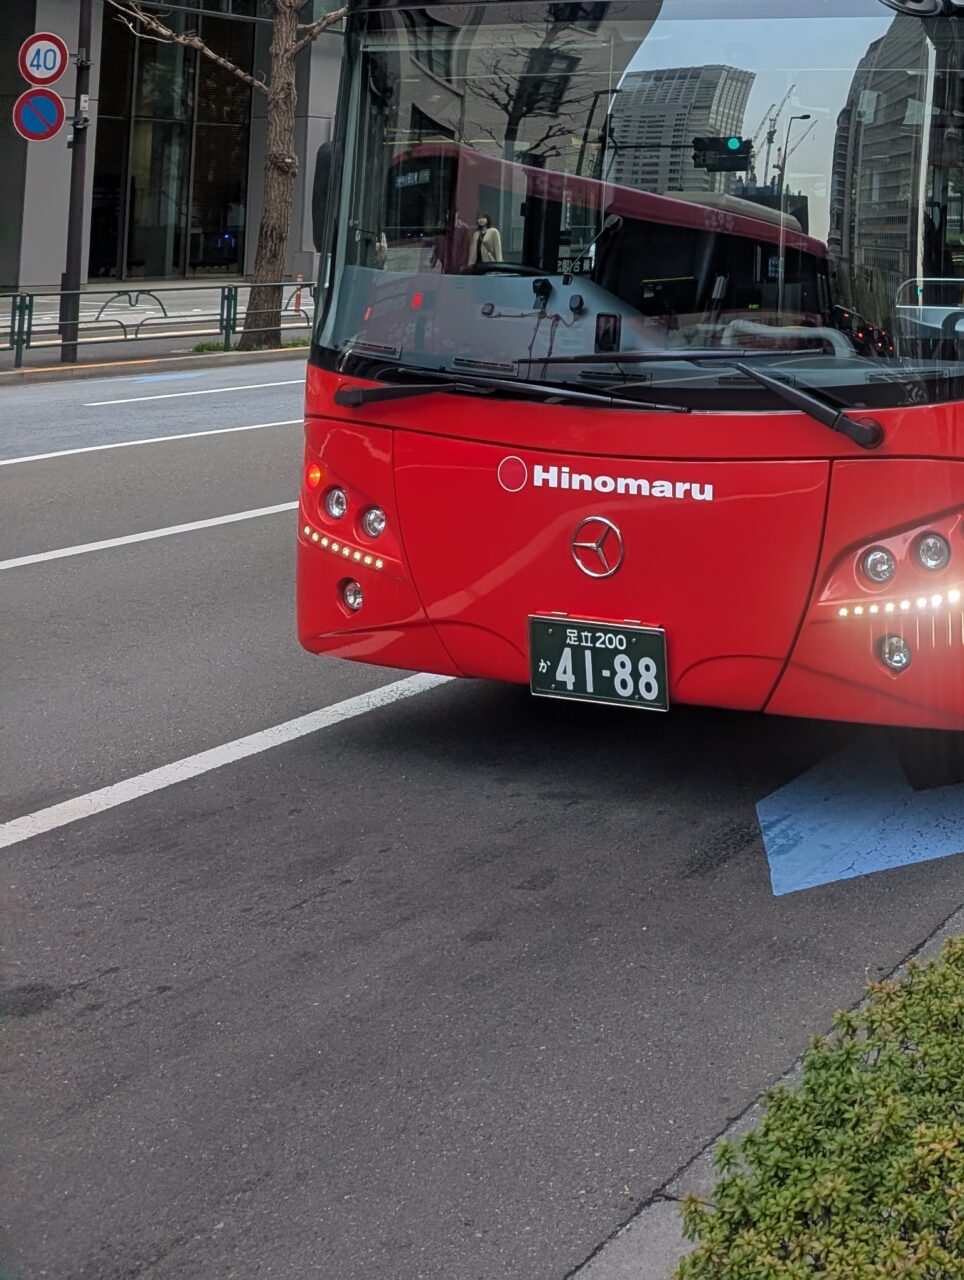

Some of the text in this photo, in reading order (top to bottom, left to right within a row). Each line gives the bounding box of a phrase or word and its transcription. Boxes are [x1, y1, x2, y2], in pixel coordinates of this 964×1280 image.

[29, 48, 57, 71] 40
[533, 464, 713, 501] Hinomaru
[555, 647, 659, 700] 41-88
